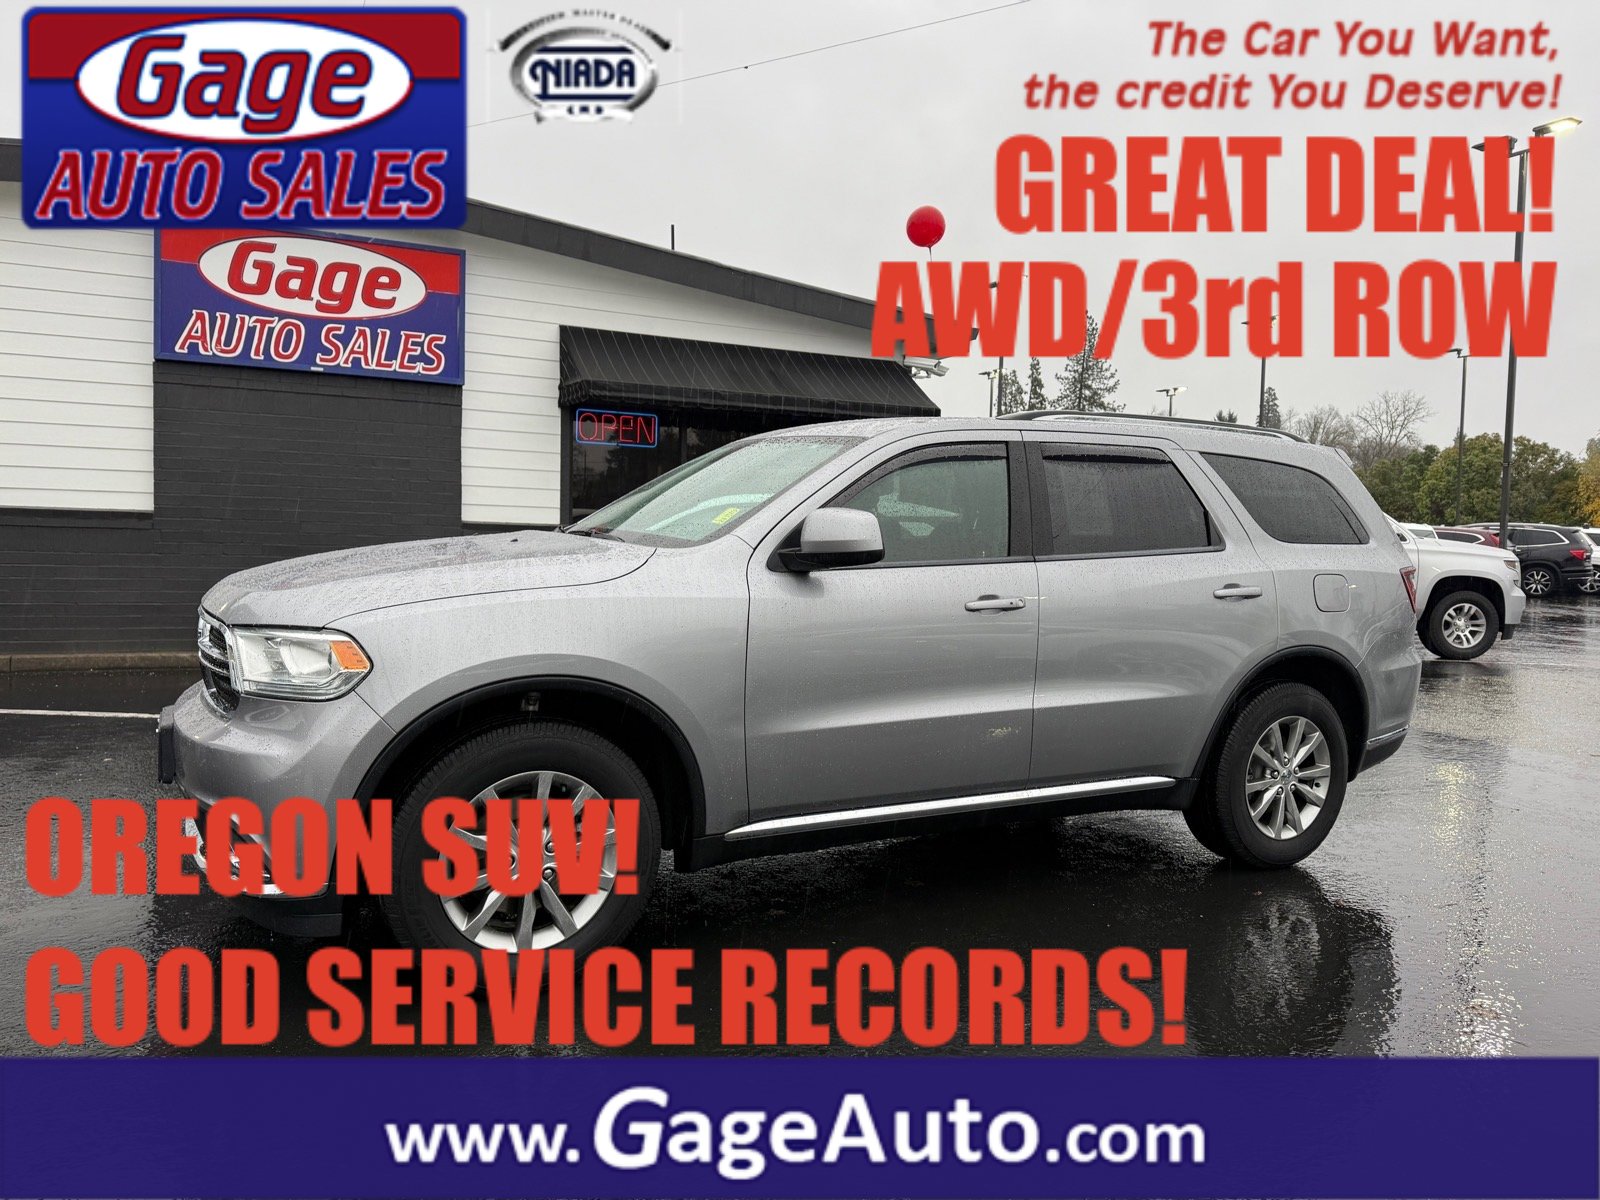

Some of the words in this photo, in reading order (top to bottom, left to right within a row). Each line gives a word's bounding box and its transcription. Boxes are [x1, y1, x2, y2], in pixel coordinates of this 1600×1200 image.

[227, 240, 402, 314] Gage
[175, 310, 306, 363] AUTO
[316, 323, 446, 375] SALES
[578, 412, 655, 444] OPEN
